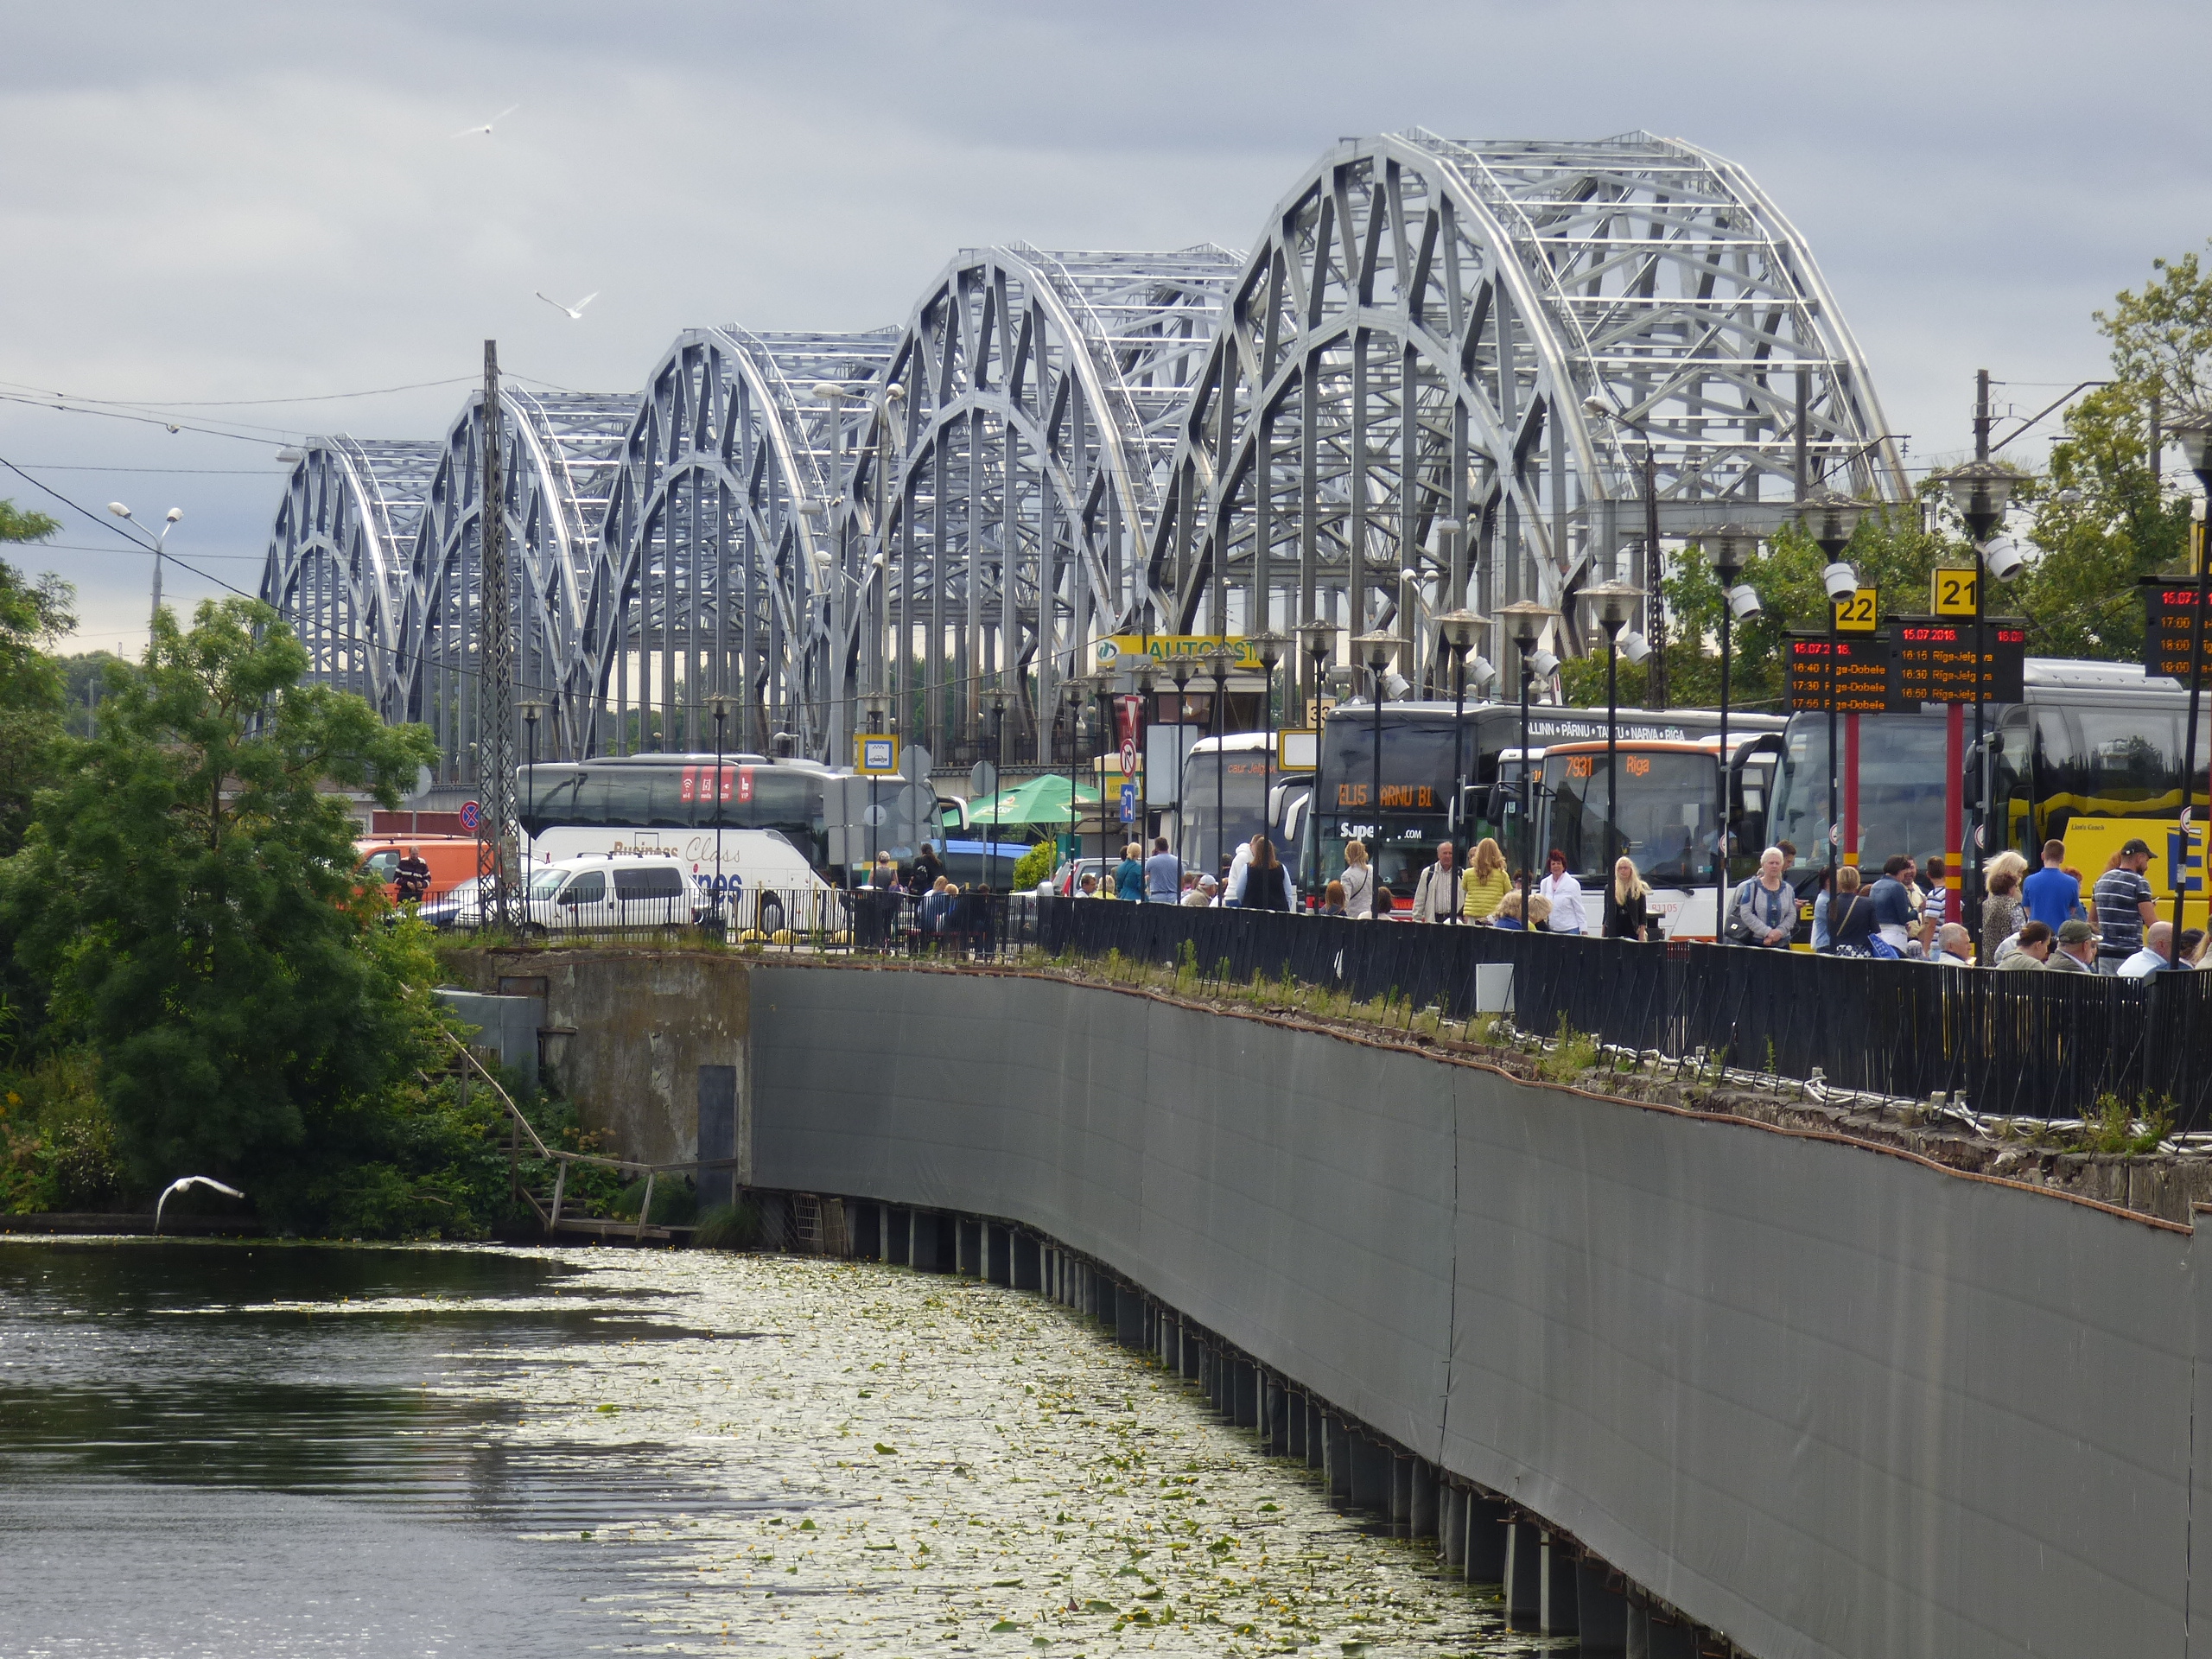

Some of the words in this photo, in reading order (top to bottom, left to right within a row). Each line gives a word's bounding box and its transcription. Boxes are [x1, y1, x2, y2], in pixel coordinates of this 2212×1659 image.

[1942, 580, 1976, 606] 21
[1838, 598, 1872, 621] 22
[2162, 617, 2190, 629] 17:00
[1310, 706, 1331, 721] 33
[1520, 721, 1554, 735] ALLINN
[1561, 721, 1590, 737] PÄRNU
[1597, 725, 1624, 740] TATU
[1630, 728, 1658, 741] NARVA
[1228, 764, 1247, 773] caur
[1565, 756, 1593, 777] 7931
[1626, 755, 1650, 777] Riga
[1339, 784, 1368, 806] EL15
[1380, 785, 1413, 807] ÄRNU
[1418, 785, 1433, 807] B1
[685, 836, 741, 862] Class
